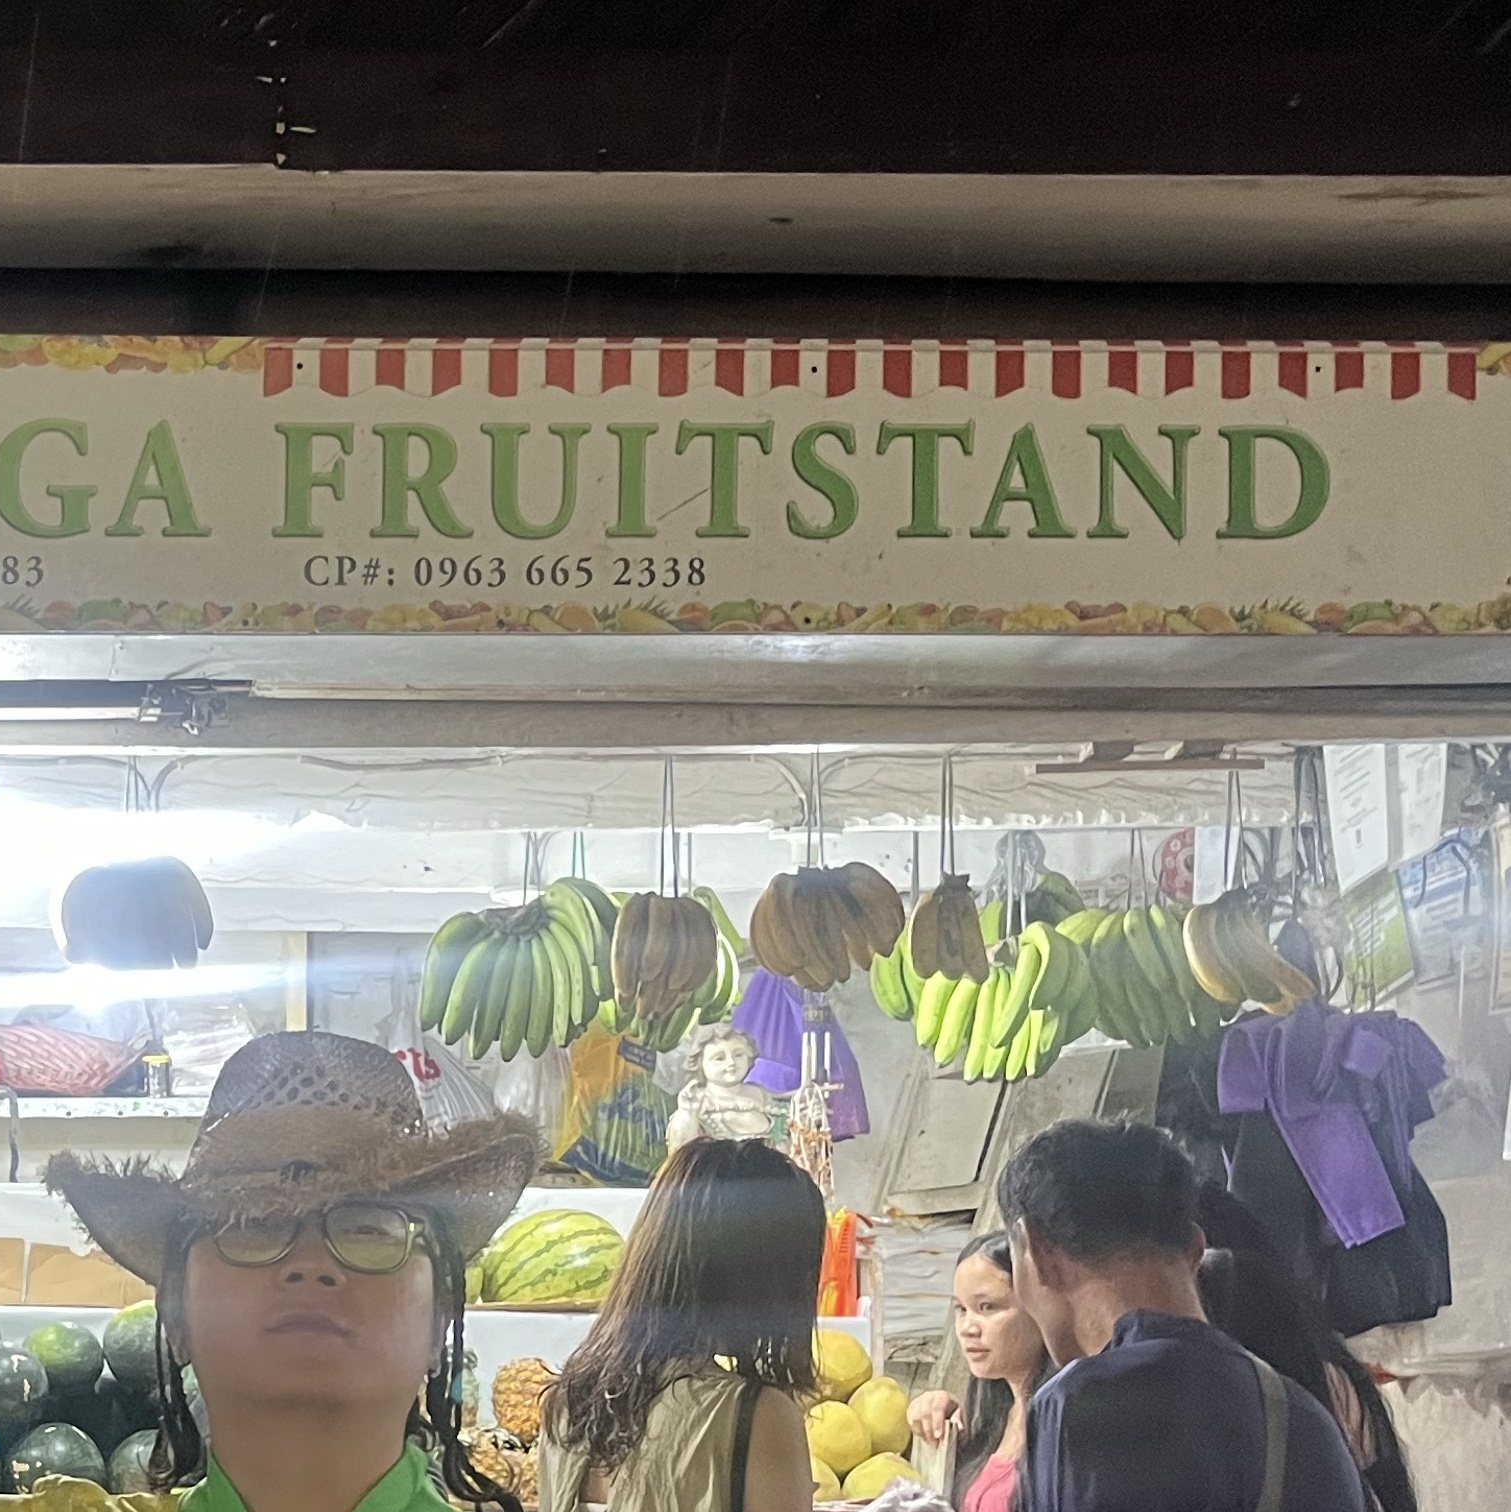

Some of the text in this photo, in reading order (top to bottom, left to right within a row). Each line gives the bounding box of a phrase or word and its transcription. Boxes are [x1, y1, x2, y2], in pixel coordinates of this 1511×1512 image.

[271, 418, 1331, 541] FRUITSTAND
[303, 554, 707, 588] CP#: 0963 665 2338
